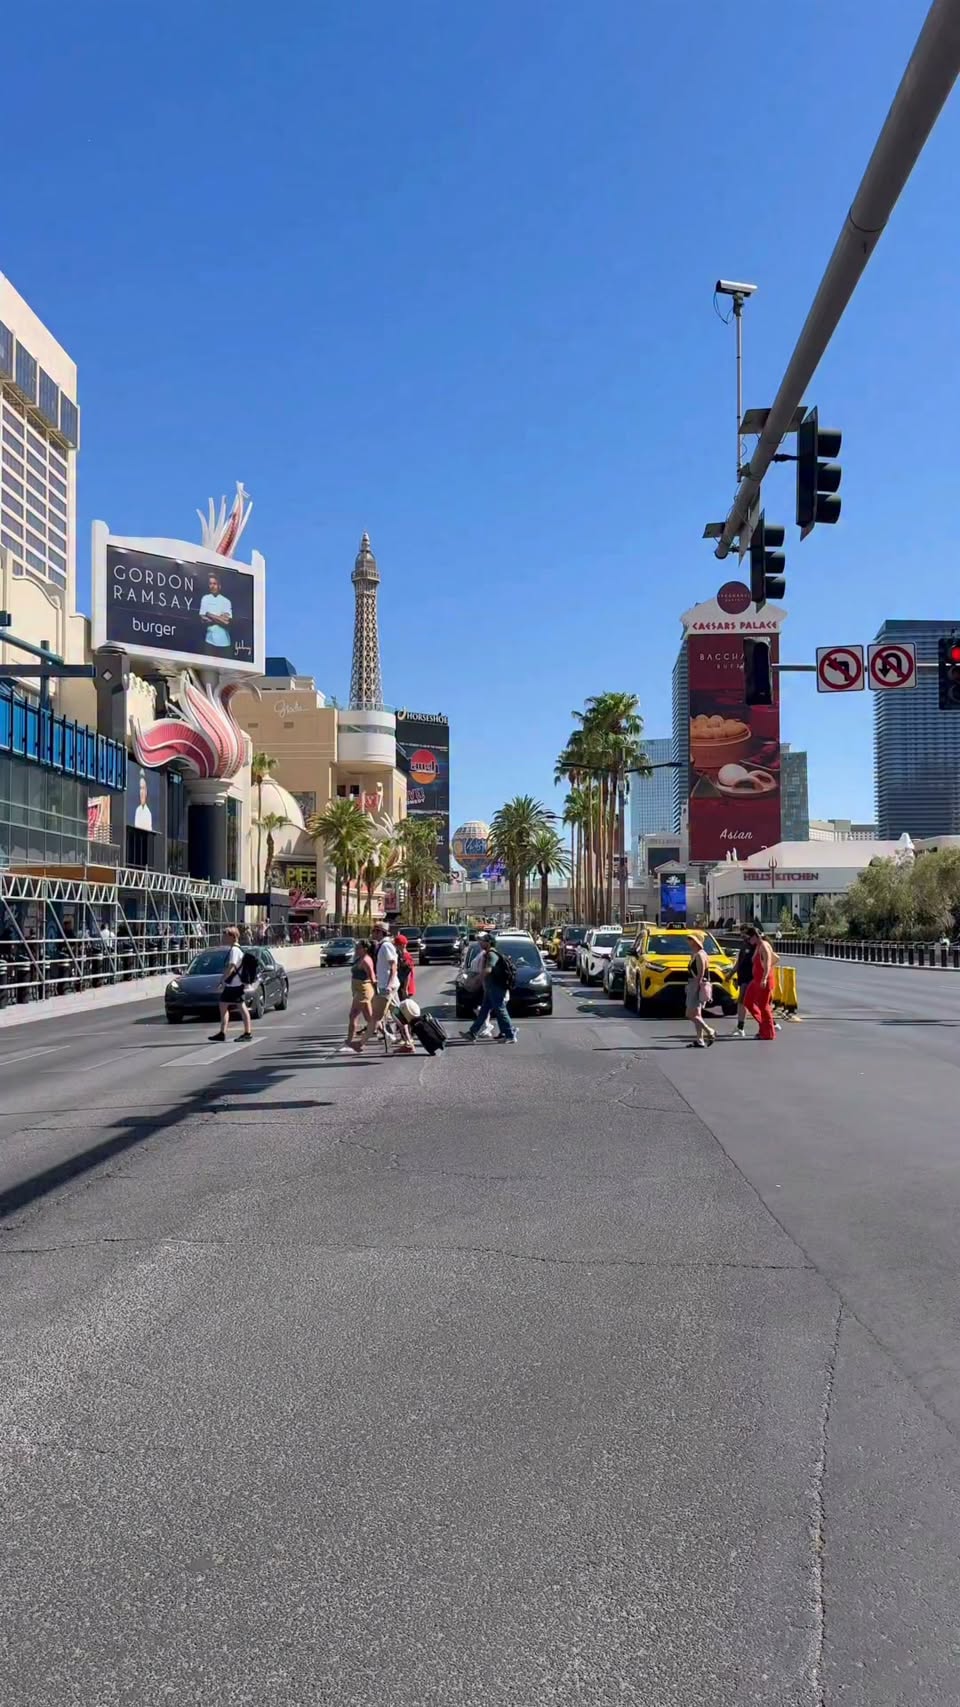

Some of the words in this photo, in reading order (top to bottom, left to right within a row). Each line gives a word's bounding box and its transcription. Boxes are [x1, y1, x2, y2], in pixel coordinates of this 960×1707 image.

[113, 565, 194, 592] GORDON
[113, 585, 193, 611] RAMSAY
[131, 617, 177, 637] burger
[692, 621, 736, 631] CAESARS
[739, 620, 777, 630] PALACE
[699, 653, 744, 661] BACCHA
[719, 828, 754, 840] Asian
[775, 872, 819, 881] KITCHEN
